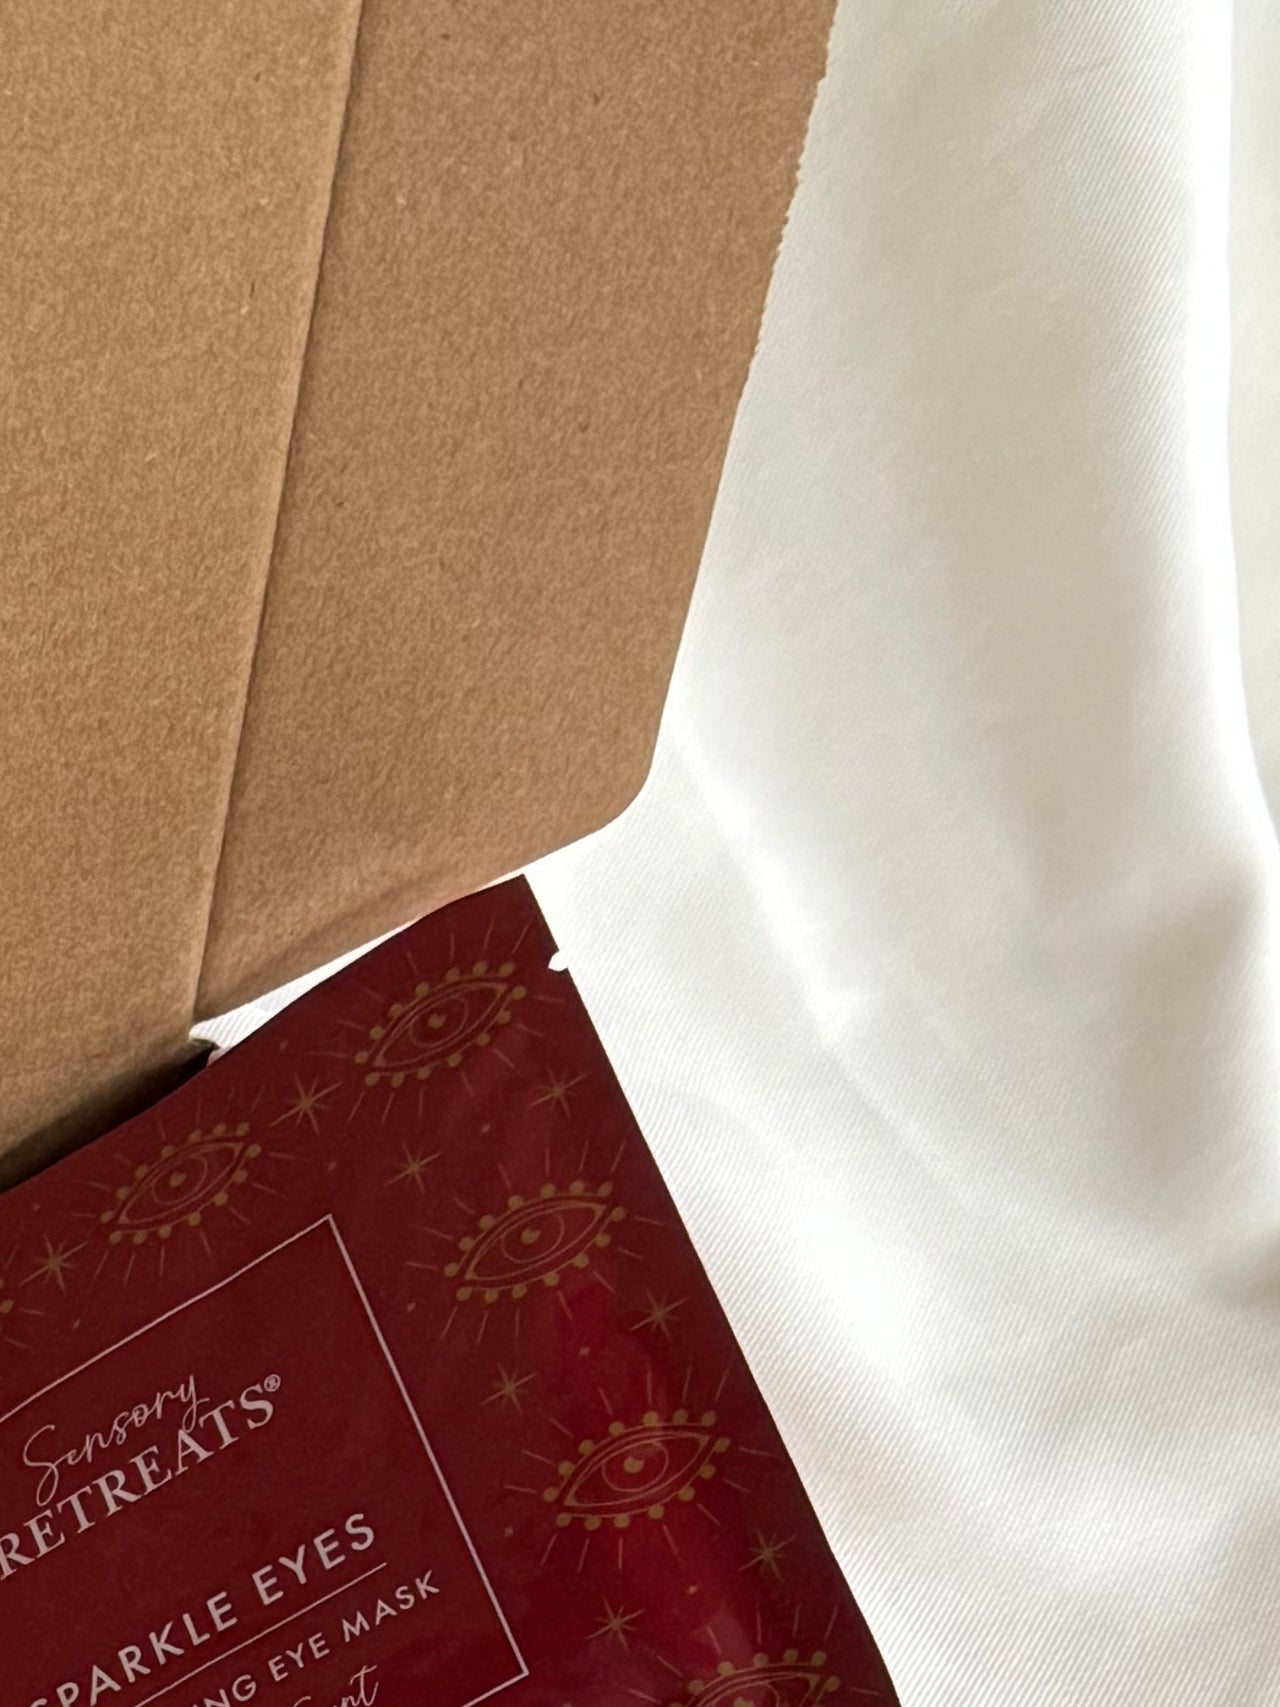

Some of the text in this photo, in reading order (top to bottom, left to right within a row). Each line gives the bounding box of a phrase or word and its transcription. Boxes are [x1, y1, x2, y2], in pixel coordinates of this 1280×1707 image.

[23, 1375, 209, 1505] Sensory
[252, 1512, 376, 1606] EYES
[268, 1632, 330, 1681] EYE
[342, 1571, 440, 1642] MASK
